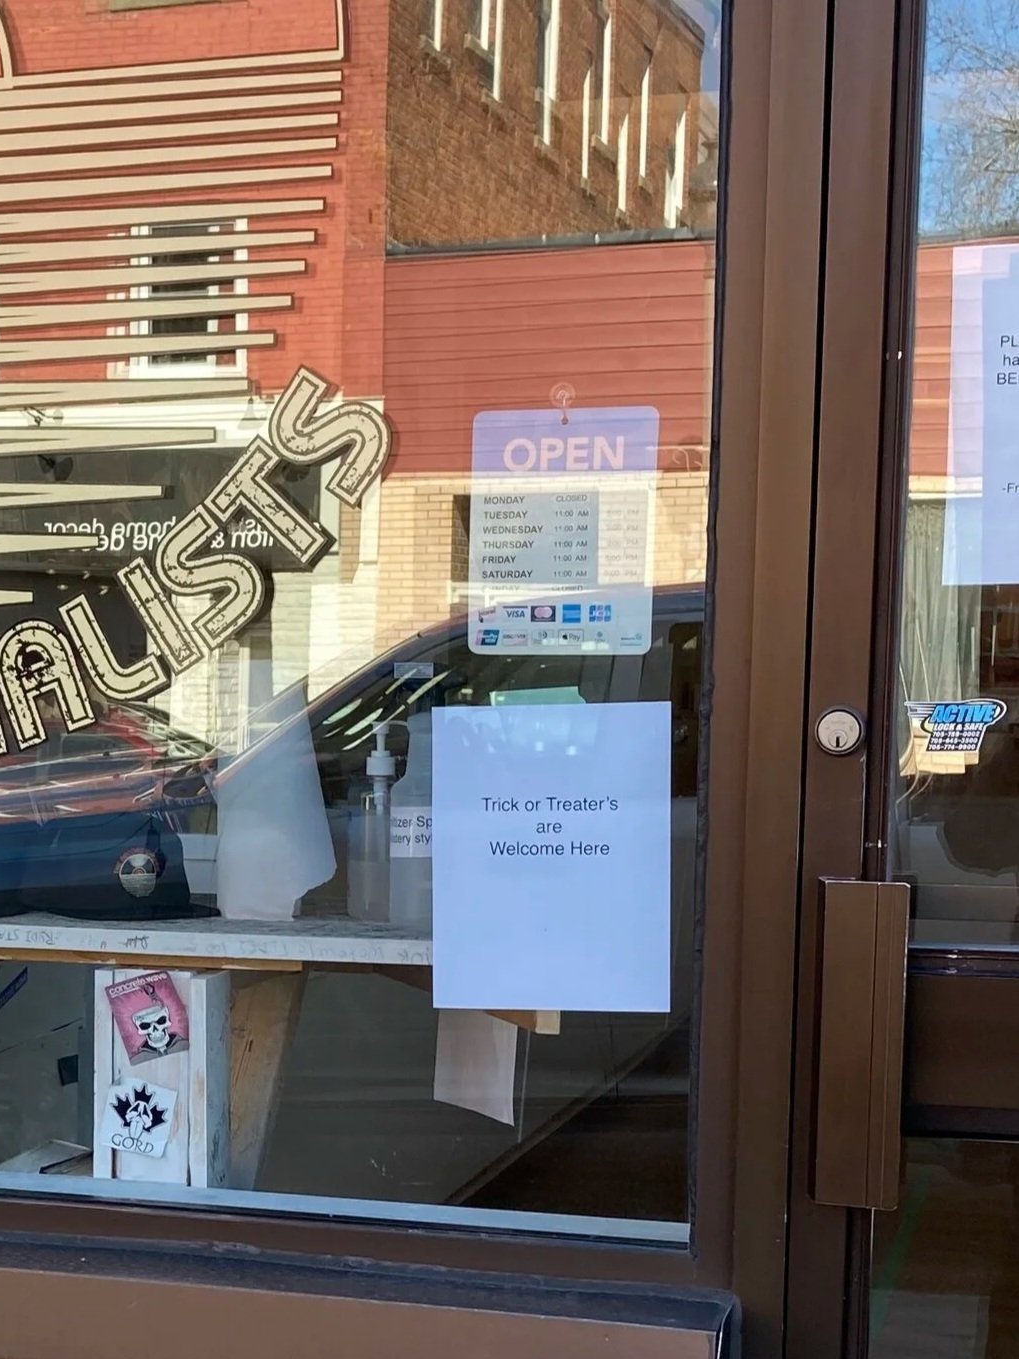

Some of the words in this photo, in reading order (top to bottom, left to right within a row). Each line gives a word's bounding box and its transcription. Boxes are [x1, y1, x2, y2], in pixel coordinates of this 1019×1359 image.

[502, 436, 625, 472] OPEN
[483, 496, 525, 505] MONDAY
[483, 511, 528, 519] TUESDAY
[482, 526, 543, 534] WEDNESDAY
[482, 541, 534, 549] THURSDAY
[482, 556, 516, 564] FRIDAY
[482, 570, 533, 579] SATURDAY
[506, 610, 526, 619] VISA
[928, 703, 998, 723] ACTIVE
[933, 723, 954, 731] LOCK
[963, 722, 985, 731] SAFE
[482, 796, 519, 812] Trick
[524, 800, 541, 812] or
[546, 796, 619, 812] Treater's
[536, 821, 563, 834] are
[489, 841, 565, 856] Welcome
[570, 841, 610, 856] Here
[108, 977, 146, 995] concrete
[145, 973, 168, 983] wave
[111, 1133, 154, 1154] GORD
